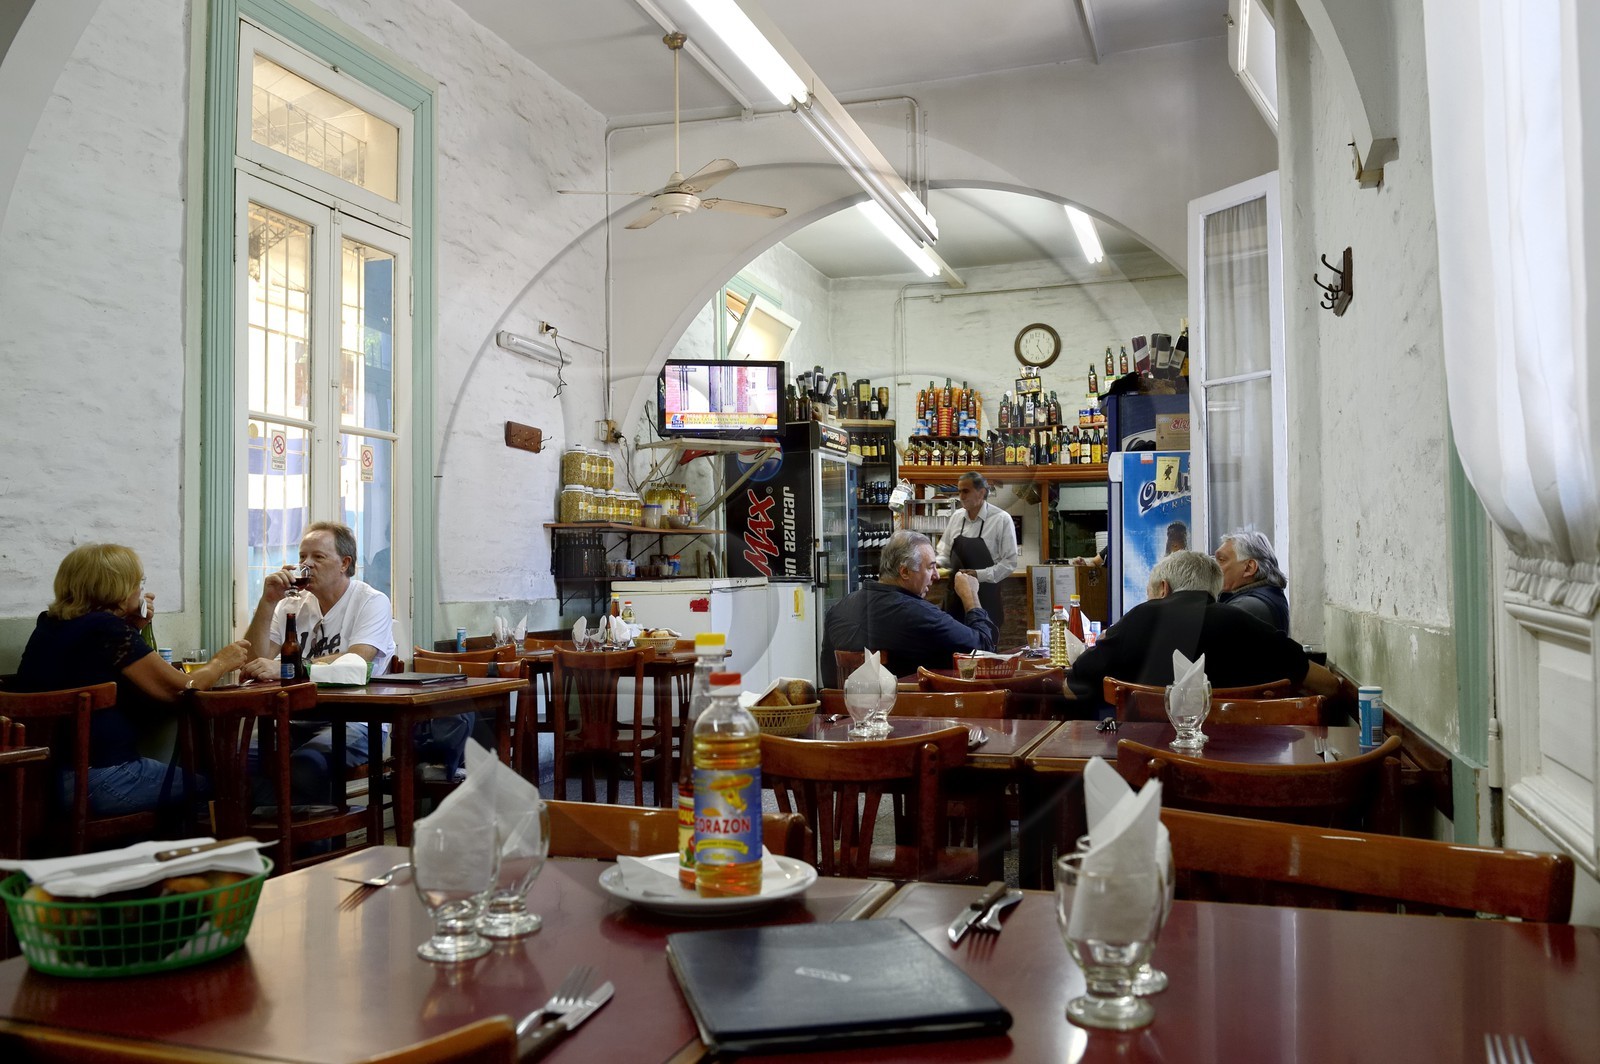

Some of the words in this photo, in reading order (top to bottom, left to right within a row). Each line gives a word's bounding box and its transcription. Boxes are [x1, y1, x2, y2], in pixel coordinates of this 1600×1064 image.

[743, 489, 779, 577] MAX
[782, 486, 796, 553] azúcar
[785, 557, 796, 577] in
